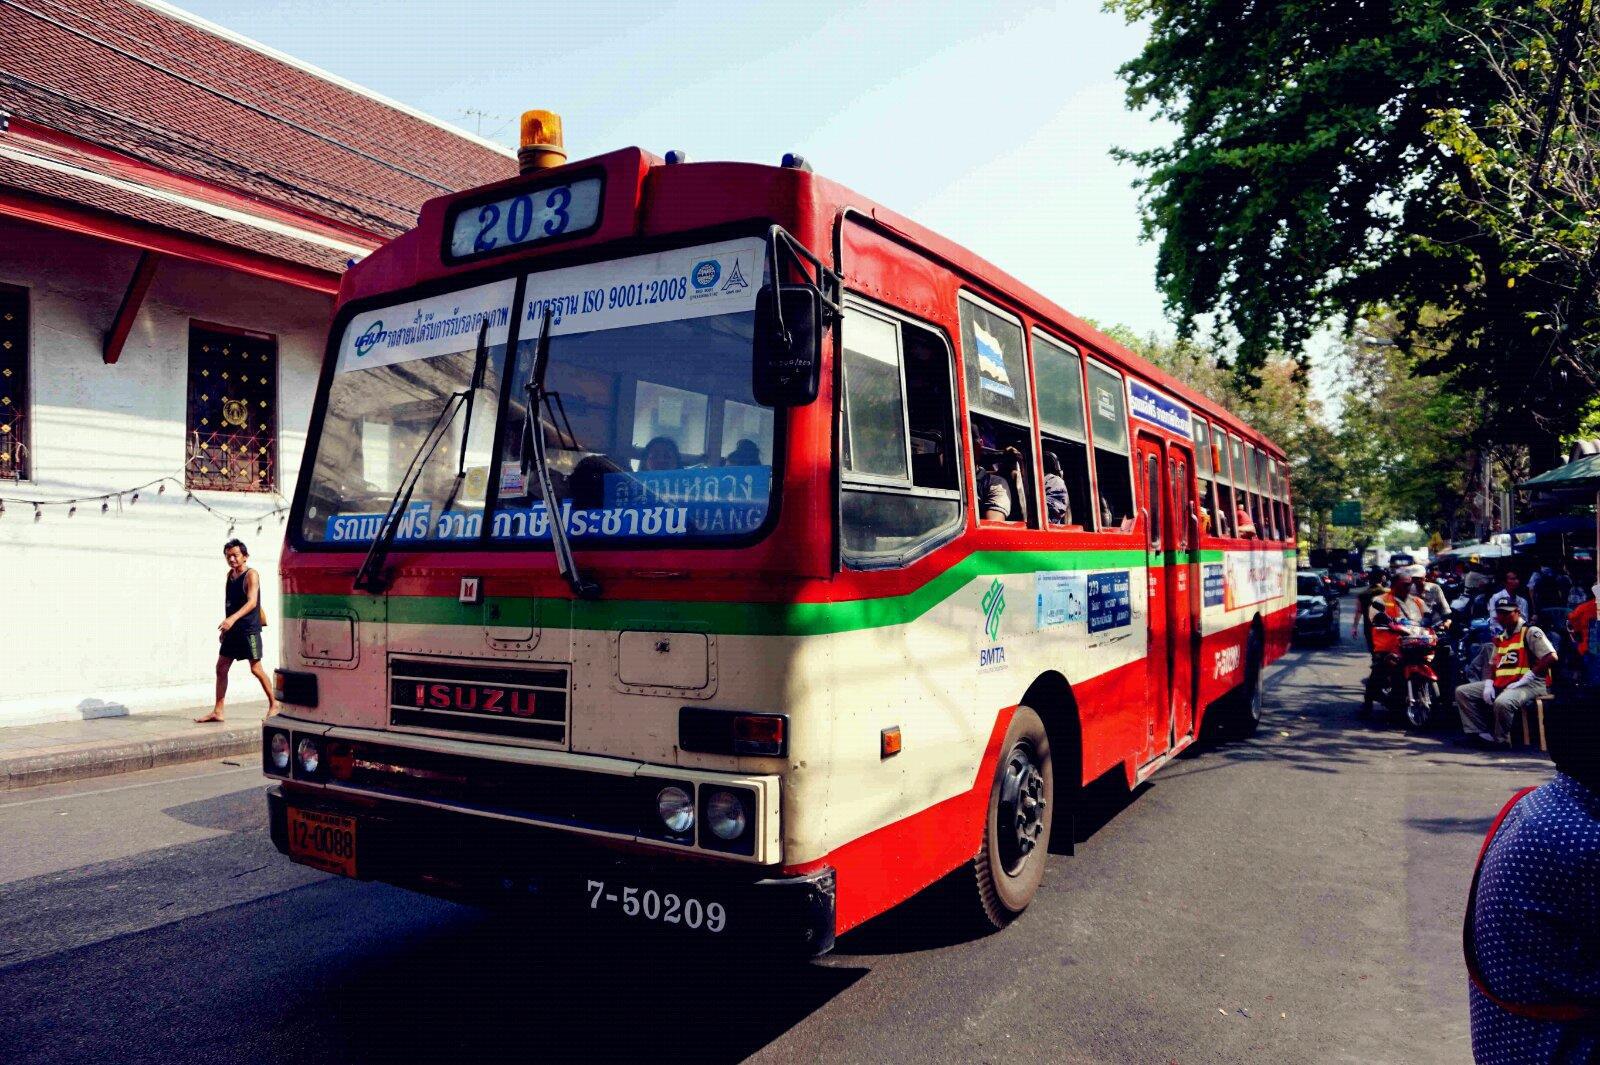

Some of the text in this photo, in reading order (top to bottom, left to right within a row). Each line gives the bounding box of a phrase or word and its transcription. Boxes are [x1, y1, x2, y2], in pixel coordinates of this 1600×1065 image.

[473, 186, 572, 252] 203
[527, 276, 687, 326] มาตรฐาน ISO 9001:2008
[980, 646, 1006, 667] BMTA
[415, 683, 537, 717] ISUZU
[587, 878, 727, 934] 7-50209
